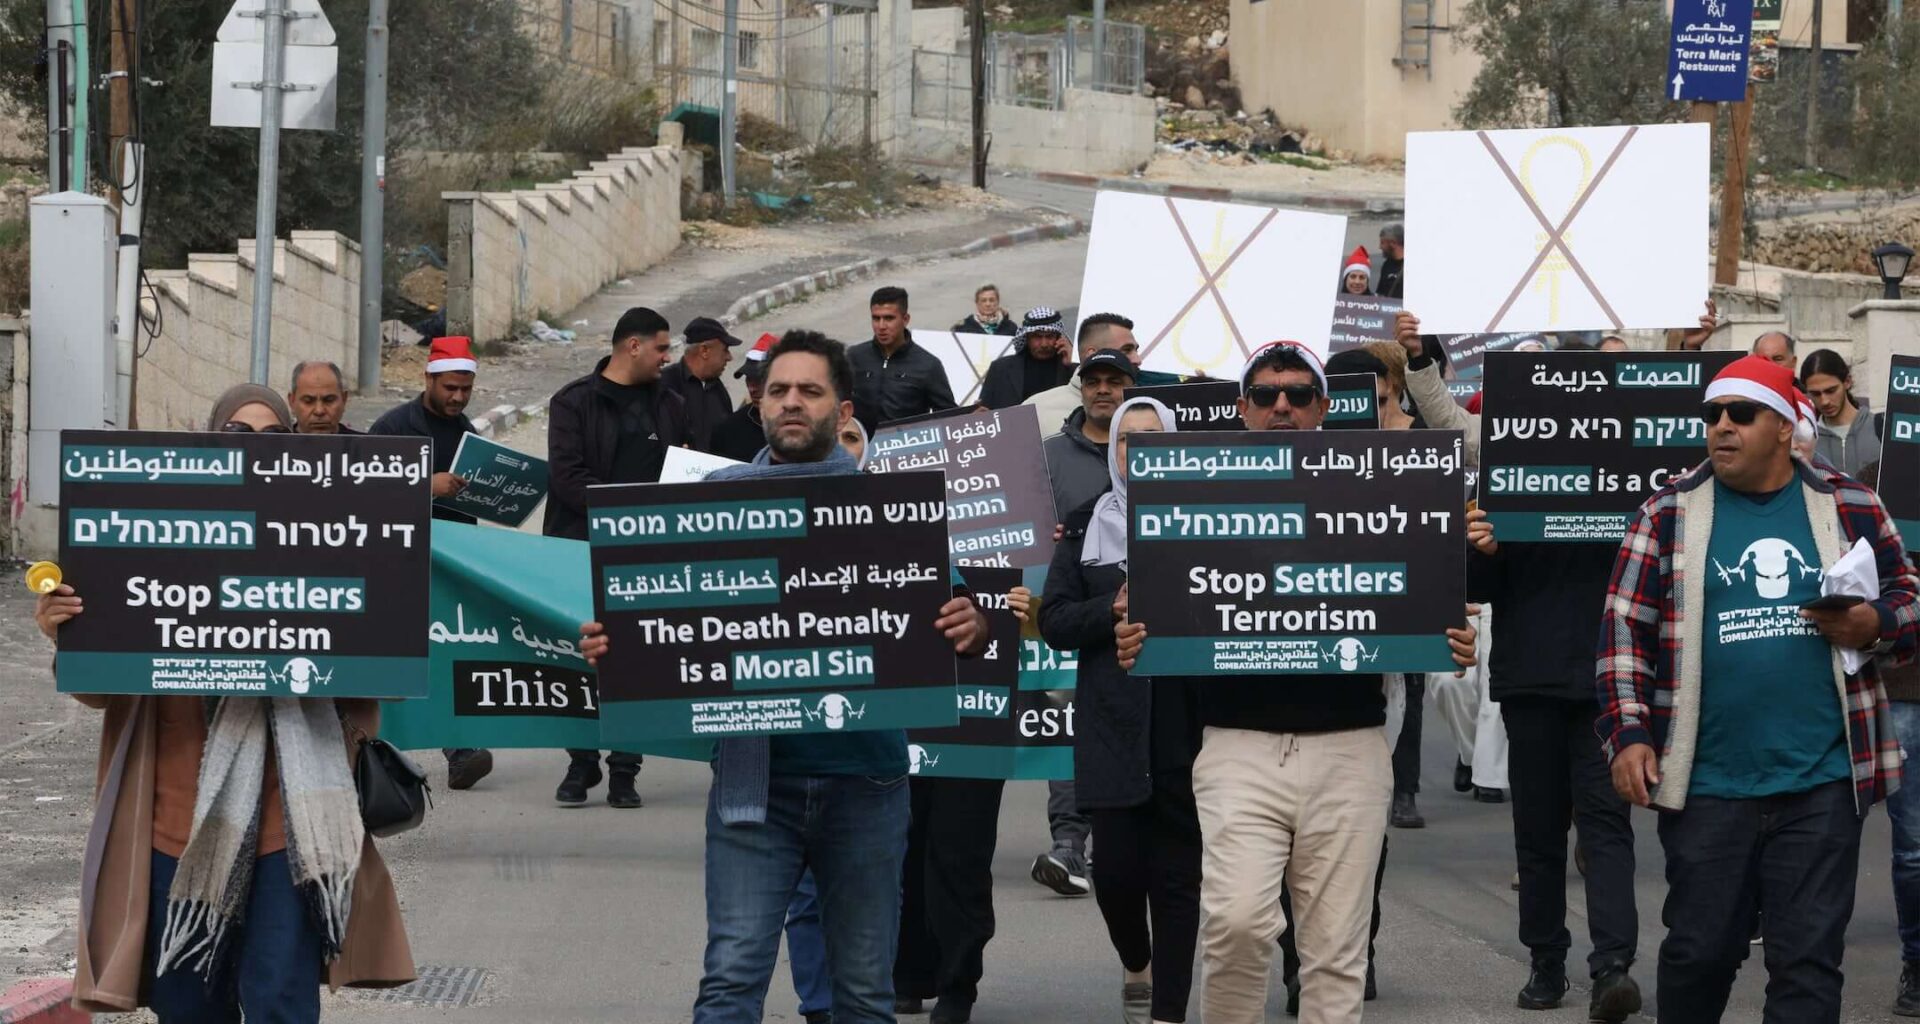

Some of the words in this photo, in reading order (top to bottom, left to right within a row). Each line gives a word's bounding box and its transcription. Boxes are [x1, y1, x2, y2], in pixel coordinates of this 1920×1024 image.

[1677, 33, 1715, 44] ماريس
[1686, 22, 1735, 32] مطعم
[1718, 34, 1744, 45] تيرا
[1676, 48, 1705, 59] Terra
[1708, 50, 1741, 61] Maris
[1678, 62, 1736, 72] Restaurant
[1463, 349, 1472, 357] to
[1531, 364, 1608, 392] جريمة
[1618, 364, 1700, 388] الصمت
[946, 411, 1001, 443] أوقفوا
[1208, 405, 1243, 422] שע
[873, 428, 941, 457] التطهير
[1490, 417, 1558, 441] פשע
[1569, 418, 1621, 440] היא
[1634, 417, 1707, 446] תיקה
[64, 449, 244, 480] المستوطنين
[342, 445, 429, 486] أوقفوا
[897, 448, 950, 471] الضفة
[957, 443, 986, 467] في
[1130, 447, 1292, 478] المستوطنين
[1300, 447, 1374, 480] إرهاب
[1383, 438, 1462, 477] أوقفوا
[252, 452, 332, 488] إرهاب
[1490, 468, 1591, 493] Silence
[1598, 468, 1619, 492] is
[1626, 474, 1641, 492] a
[502, 481, 539, 496] حقوق
[497, 503, 519, 515] هي
[677, 507, 804, 535] כתם/חטא
[813, 504, 873, 527] מוות
[883, 501, 945, 522] עונש
[1140, 506, 1303, 536] המתנחלים
[1315, 505, 1408, 535] לטרור
[1421, 511, 1450, 534] די
[74, 511, 254, 545] המתנחלים
[266, 515, 368, 547] לטרור
[382, 524, 415, 548] די
[592, 514, 667, 537] מוסרי
[949, 528, 1034, 553] leansing
[607, 565, 692, 601] أخلاقية
[699, 569, 777, 597] خطيئة
[785, 565, 859, 594] الإعدام
[866, 562, 938, 588] عقوبة
[1188, 566, 1266, 600] Stop
[1273, 564, 1405, 594] Settlers
[126, 576, 212, 615] Stop
[220, 577, 362, 610] Settlers
[638, 618, 694, 645] The
[701, 613, 791, 642] Death
[798, 608, 910, 639] Penalty
[1215, 602, 1376, 632] Terrorism
[155, 617, 331, 650] Terrorism
[1720, 628, 1785, 644] COMBATANTS
[1787, 627, 1806, 636] FOR
[680, 657, 703, 683] is
[710, 662, 727, 682] a
[735, 650, 820, 680] Moral
[828, 650, 874, 675] Sin
[1214, 661, 1272, 669] COMBATANTS
[1273, 661, 1290, 669] FOR
[1291, 661, 1318, 669] PEACE
[152, 681, 215, 689] COMBATANTS
[216, 682, 235, 690] FOR
[236, 682, 266, 690] PEACE
[471, 668, 569, 708] This
[580, 676, 600, 710] i
[692, 723, 754, 733] COMBATANTS
[754, 721, 772, 731] FOR
[773, 720, 802, 729] PEACE
[1018, 701, 1075, 737] est
